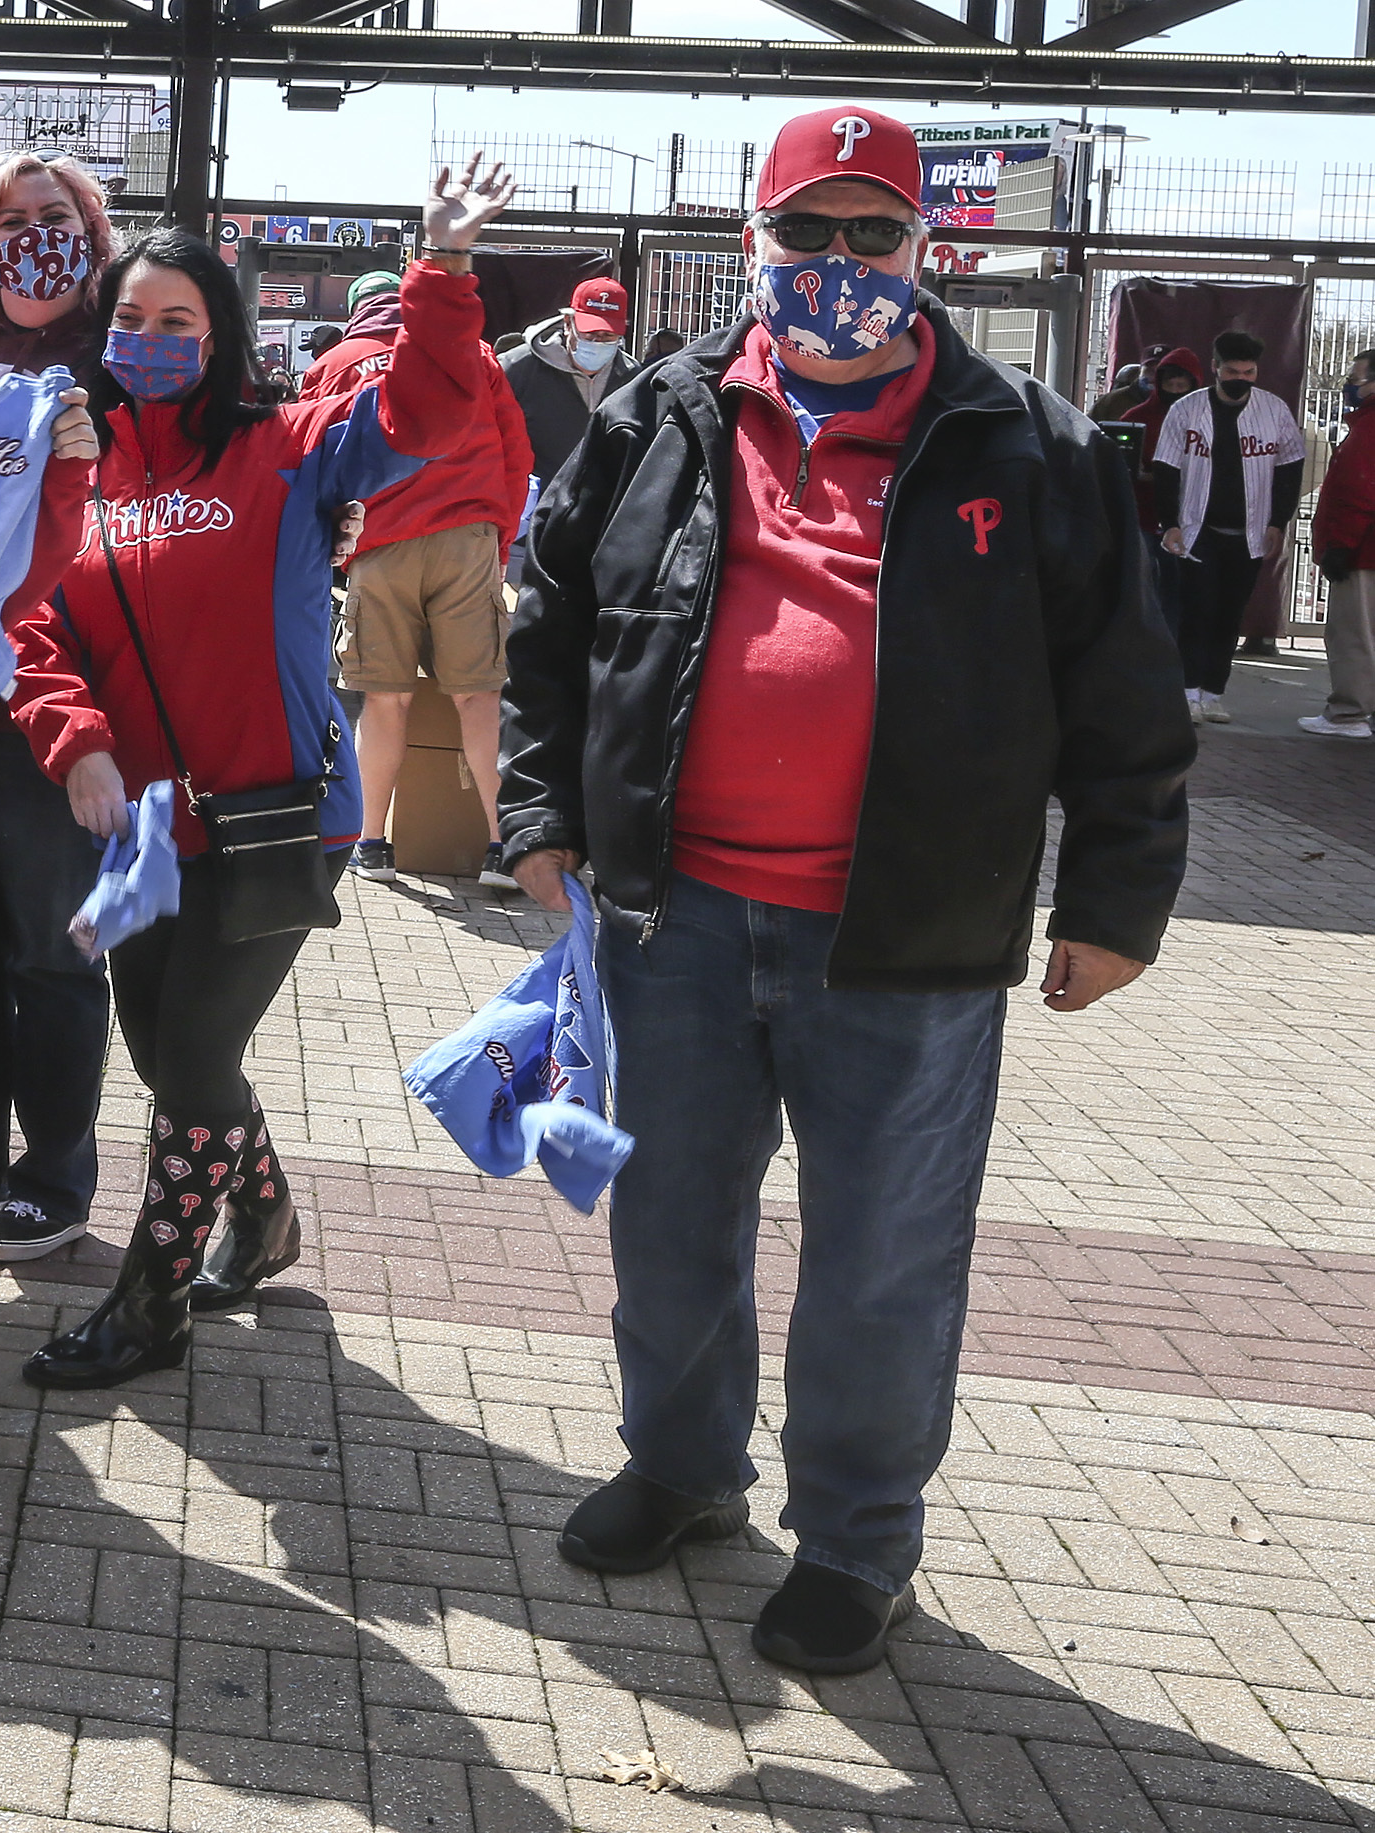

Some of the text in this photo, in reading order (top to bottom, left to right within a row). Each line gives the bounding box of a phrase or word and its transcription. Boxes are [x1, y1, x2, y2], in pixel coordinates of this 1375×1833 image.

[0, 87, 115, 127] xfinity
[831, 115, 872, 162] P
[913, 123, 1051, 142] Citizens Bank Park
[929, 164, 1000, 187] OPENIN
[793, 269, 822, 316] P
[75, 488, 235, 557] Phillies
[957, 498, 1003, 555] P
